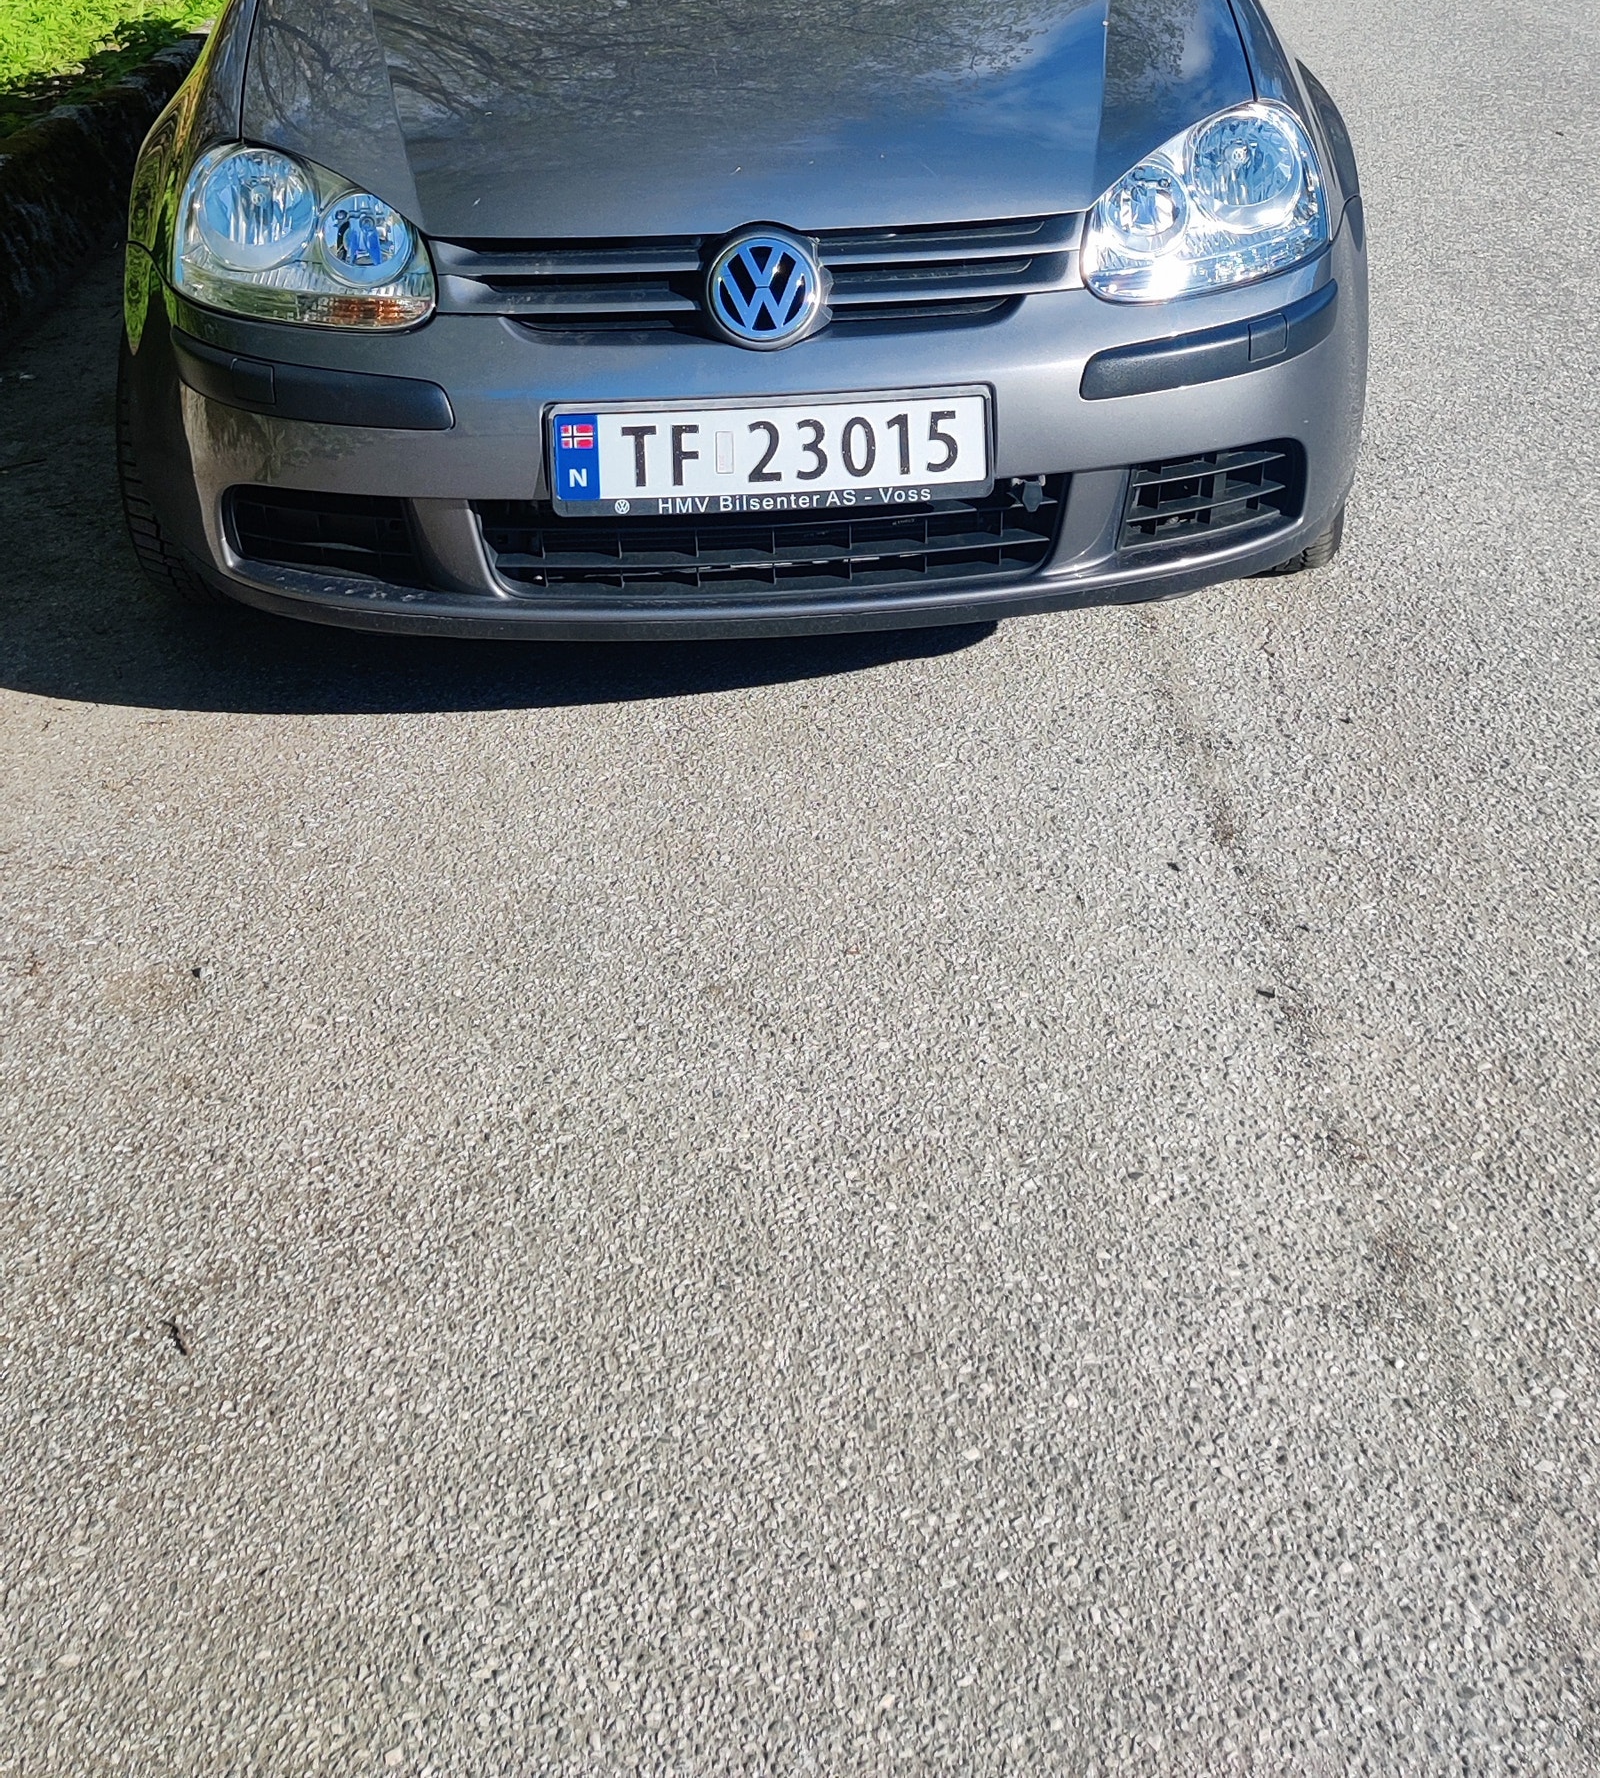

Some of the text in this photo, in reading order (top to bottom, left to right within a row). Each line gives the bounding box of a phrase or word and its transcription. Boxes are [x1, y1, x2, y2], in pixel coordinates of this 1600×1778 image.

[621, 410, 957, 487] TF 23015
[568, 468, 588, 488] N
[658, 496, 710, 514] HMV
[719, 493, 821, 512] Bilsenter
[826, 489, 857, 507] AS
[879, 486, 932, 503] Voss
